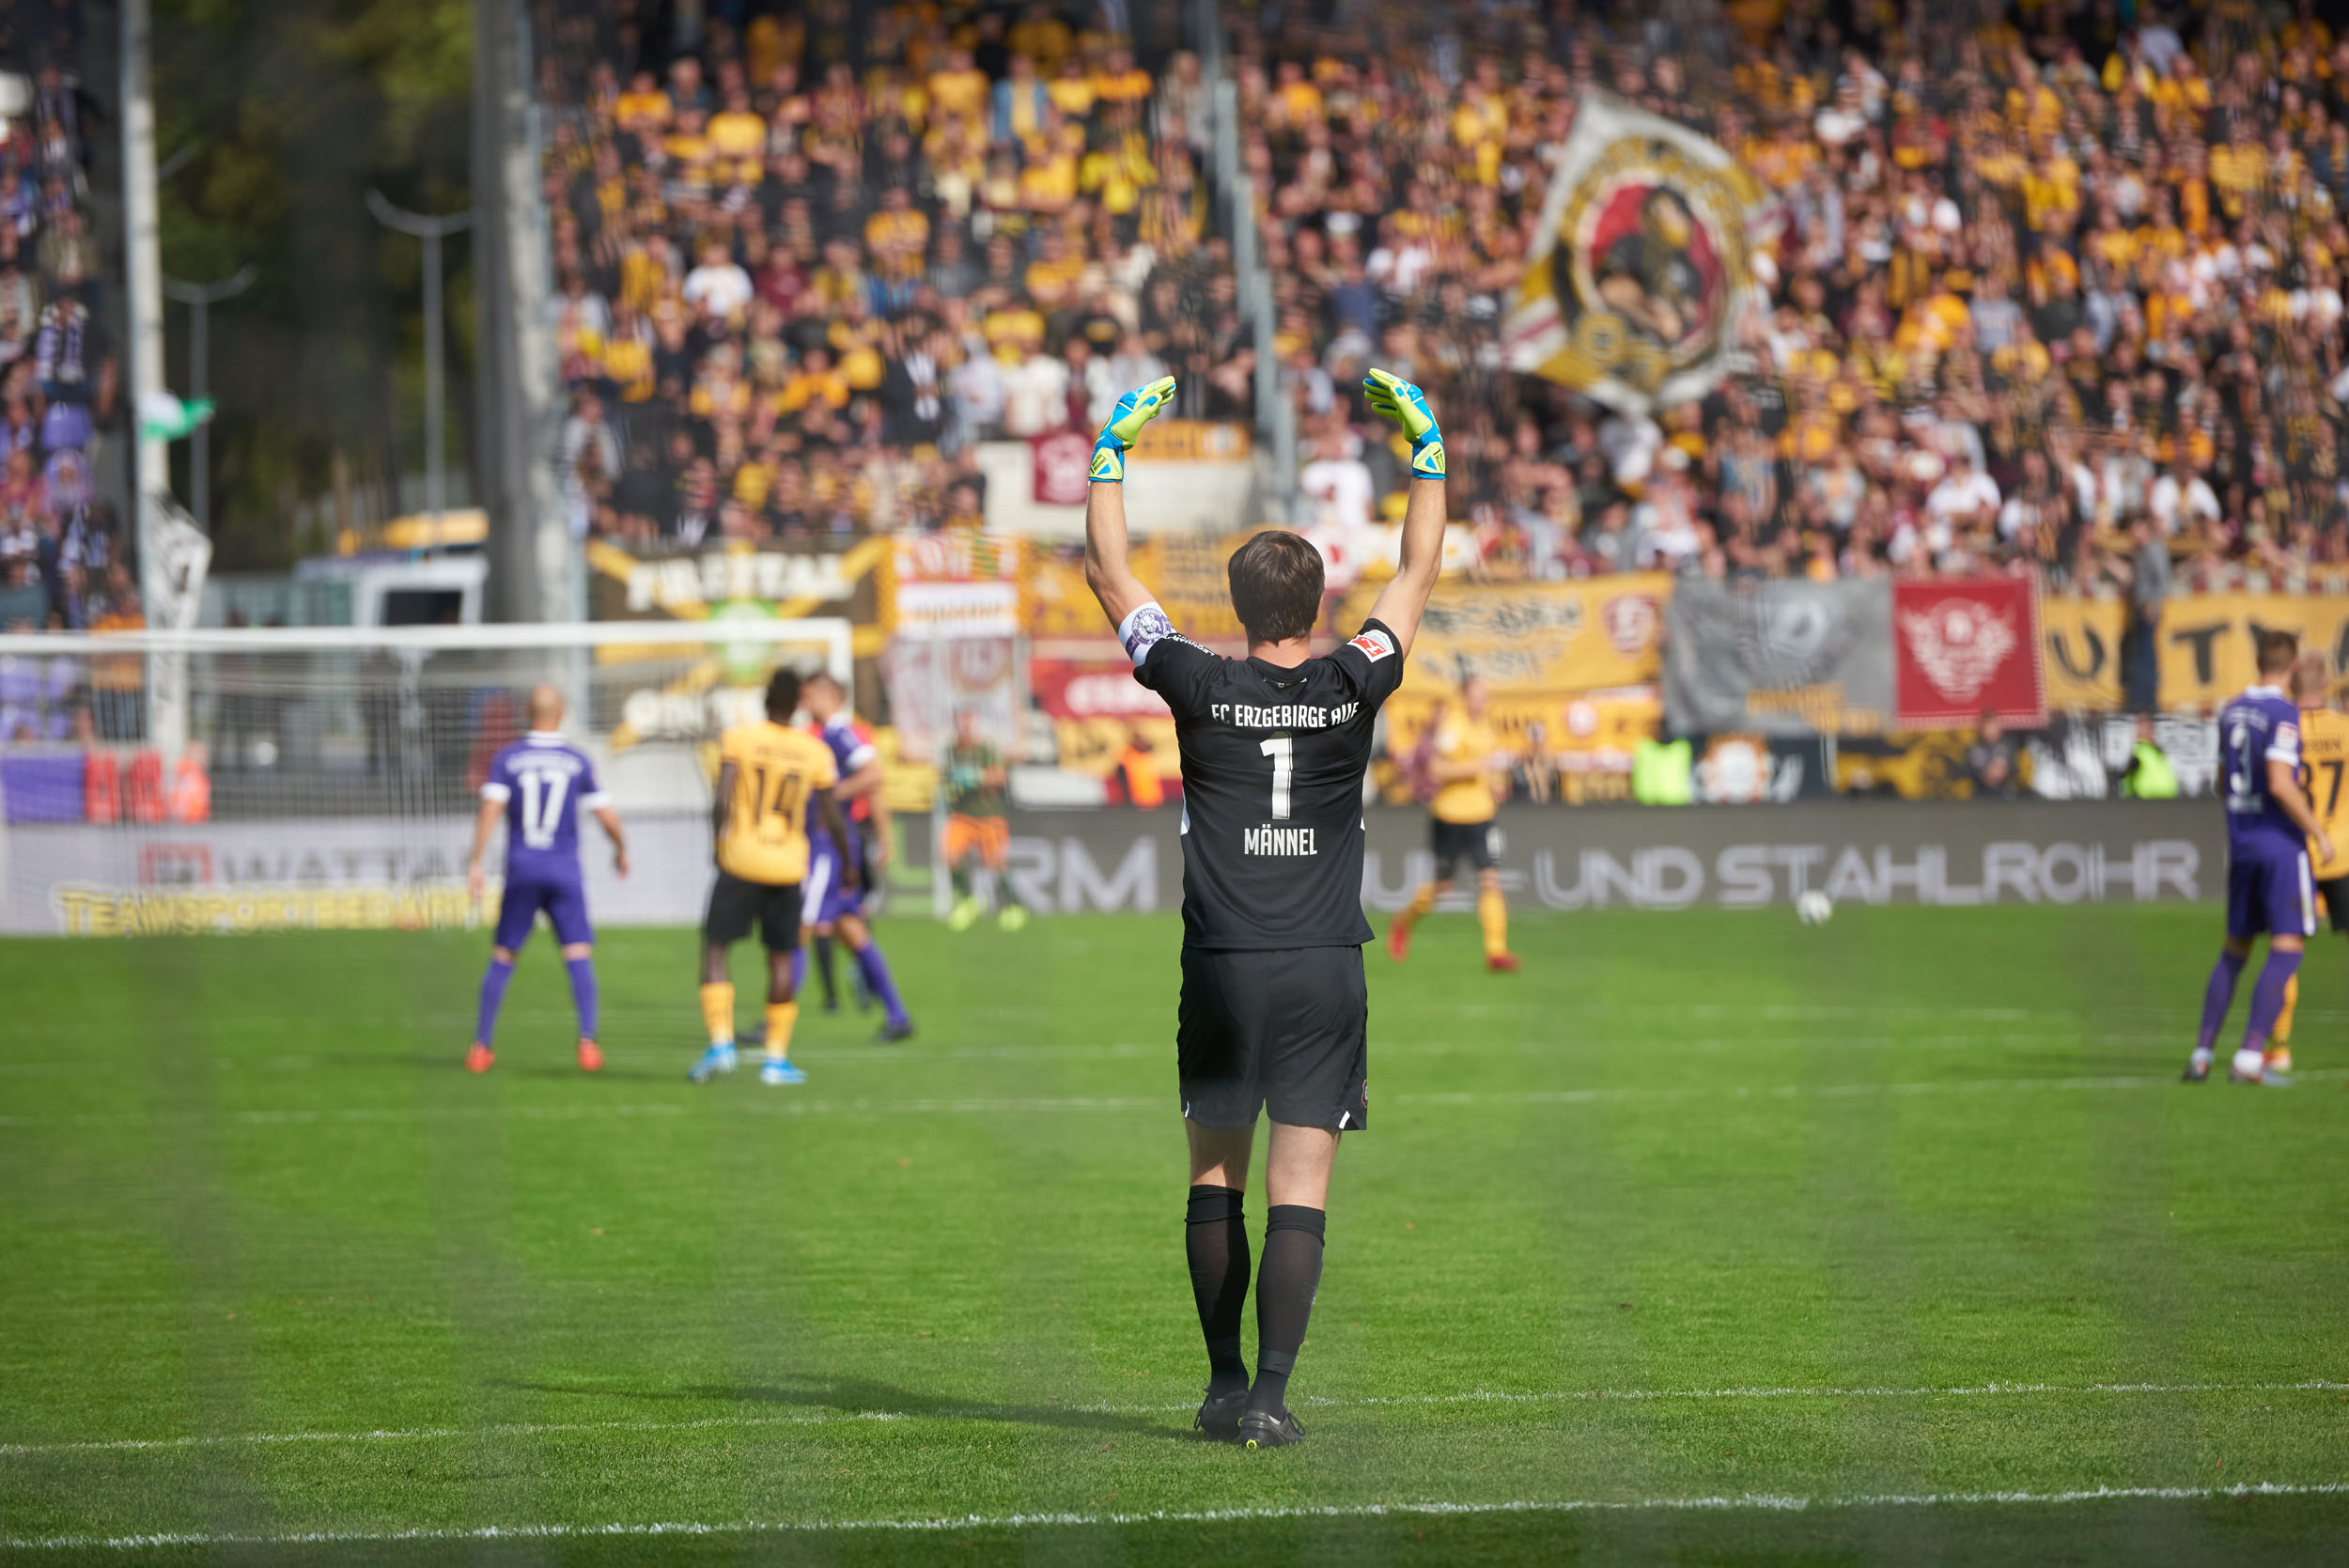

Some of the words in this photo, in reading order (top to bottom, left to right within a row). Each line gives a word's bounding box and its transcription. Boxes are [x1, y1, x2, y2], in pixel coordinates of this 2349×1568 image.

[1211, 704, 1230, 724] FC
[1236, 704, 1328, 728] ERZGEBIRGE
[518, 768, 570, 834] 17
[754, 767, 801, 829] 14
[1260, 730, 1294, 820] 1
[1244, 823, 1318, 857] MÄNNEL
[1716, 840, 2201, 909] STAHLROHR
